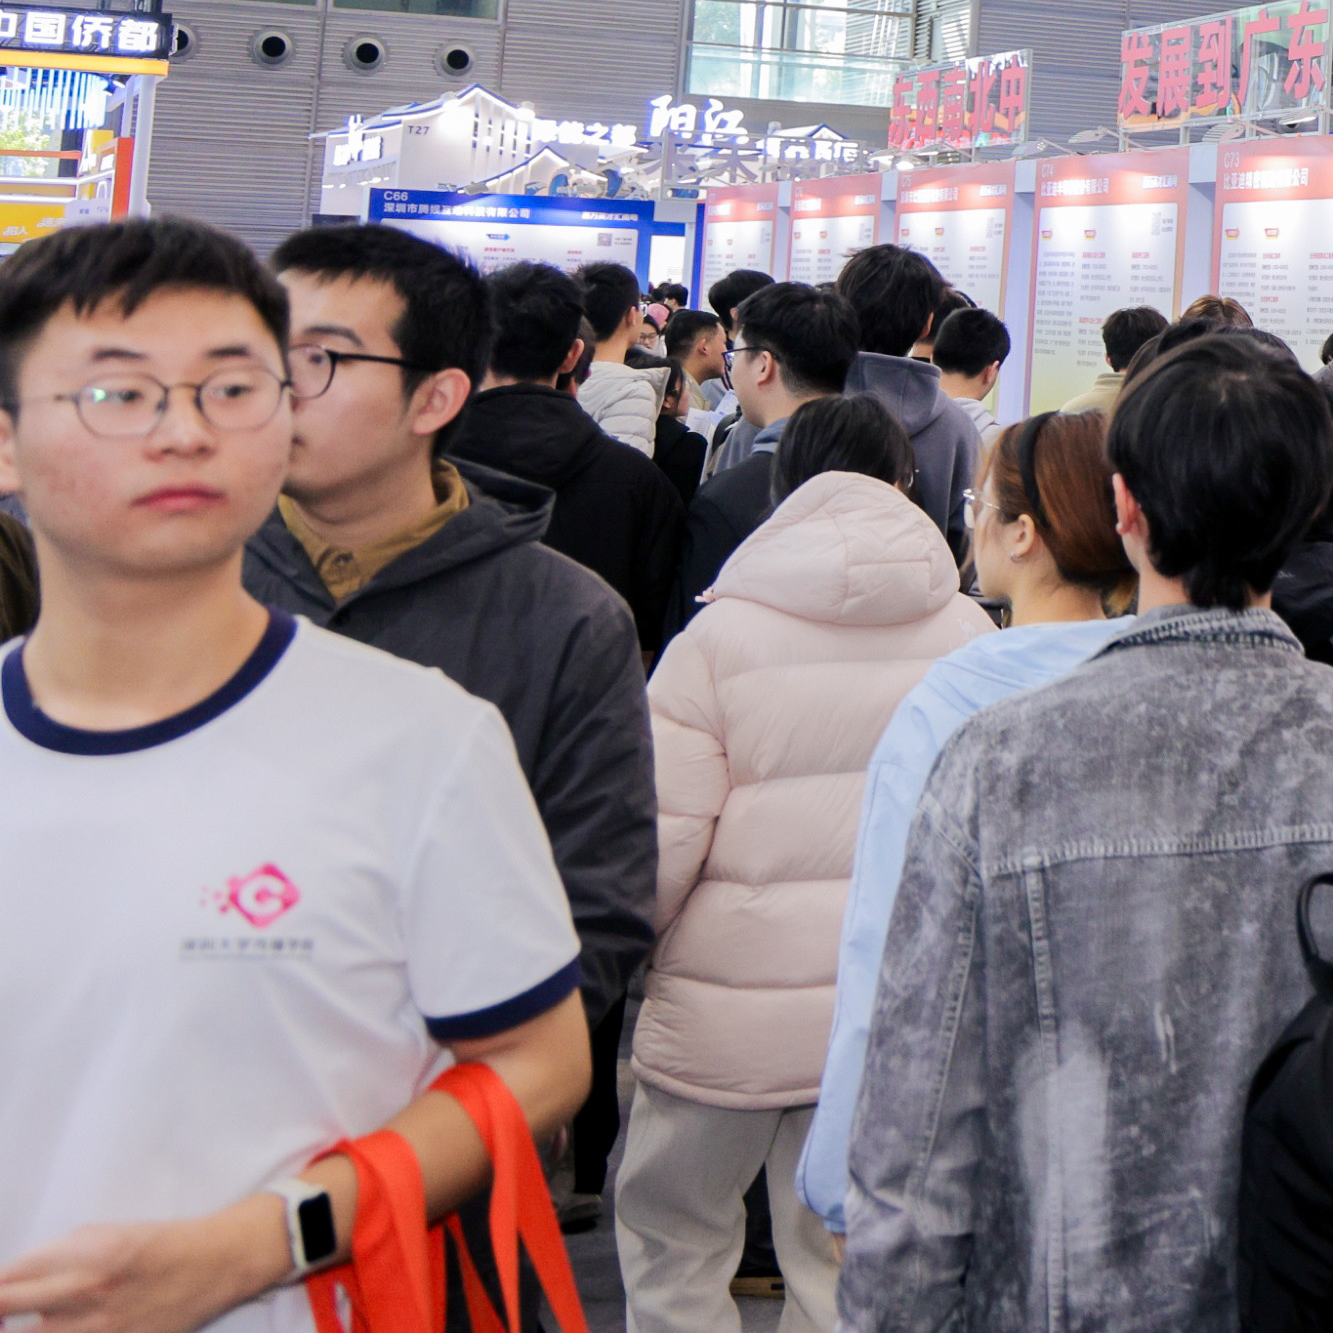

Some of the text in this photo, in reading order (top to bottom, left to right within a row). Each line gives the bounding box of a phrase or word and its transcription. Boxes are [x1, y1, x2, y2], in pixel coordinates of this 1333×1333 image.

[1117, 0, 1328, 120] 发展到广东
[889, 54, 1026, 150] 东西南北中
[407, 124, 430, 136] T27
[1224, 152, 1240, 168] C73
[383, 190, 408, 202] C66
